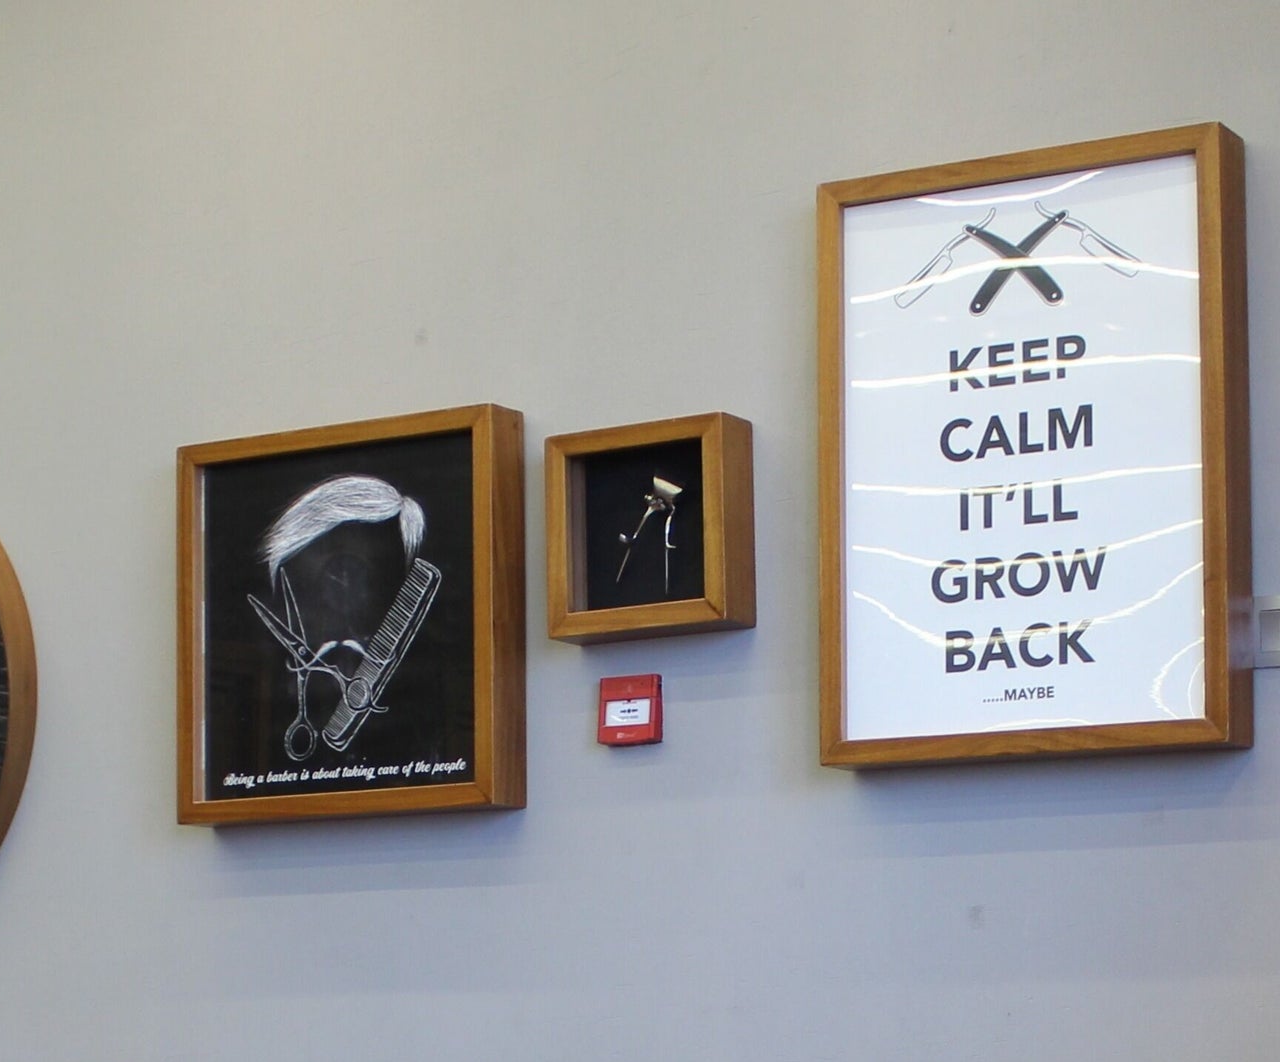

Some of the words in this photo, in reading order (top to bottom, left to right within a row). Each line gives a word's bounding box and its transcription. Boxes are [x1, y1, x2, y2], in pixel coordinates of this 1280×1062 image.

[949, 334, 1087, 393] KEEP
[939, 404, 1094, 462] CALM
[959, 478, 1079, 532] IT'LL
[931, 546, 1108, 604] GROW
[944, 617, 1096, 674] BACK
[223, 772, 255, 789] Being
[256, 775, 264, 784] a
[266, 770, 298, 783] barber
[300, 768, 310, 780] is
[311, 766, 341, 780] about
[342, 764, 377, 782] taking
[377, 765, 400, 776] care
[402, 760, 413, 778] of
[414, 760, 431, 774] the
[431, 757, 467, 776] people
